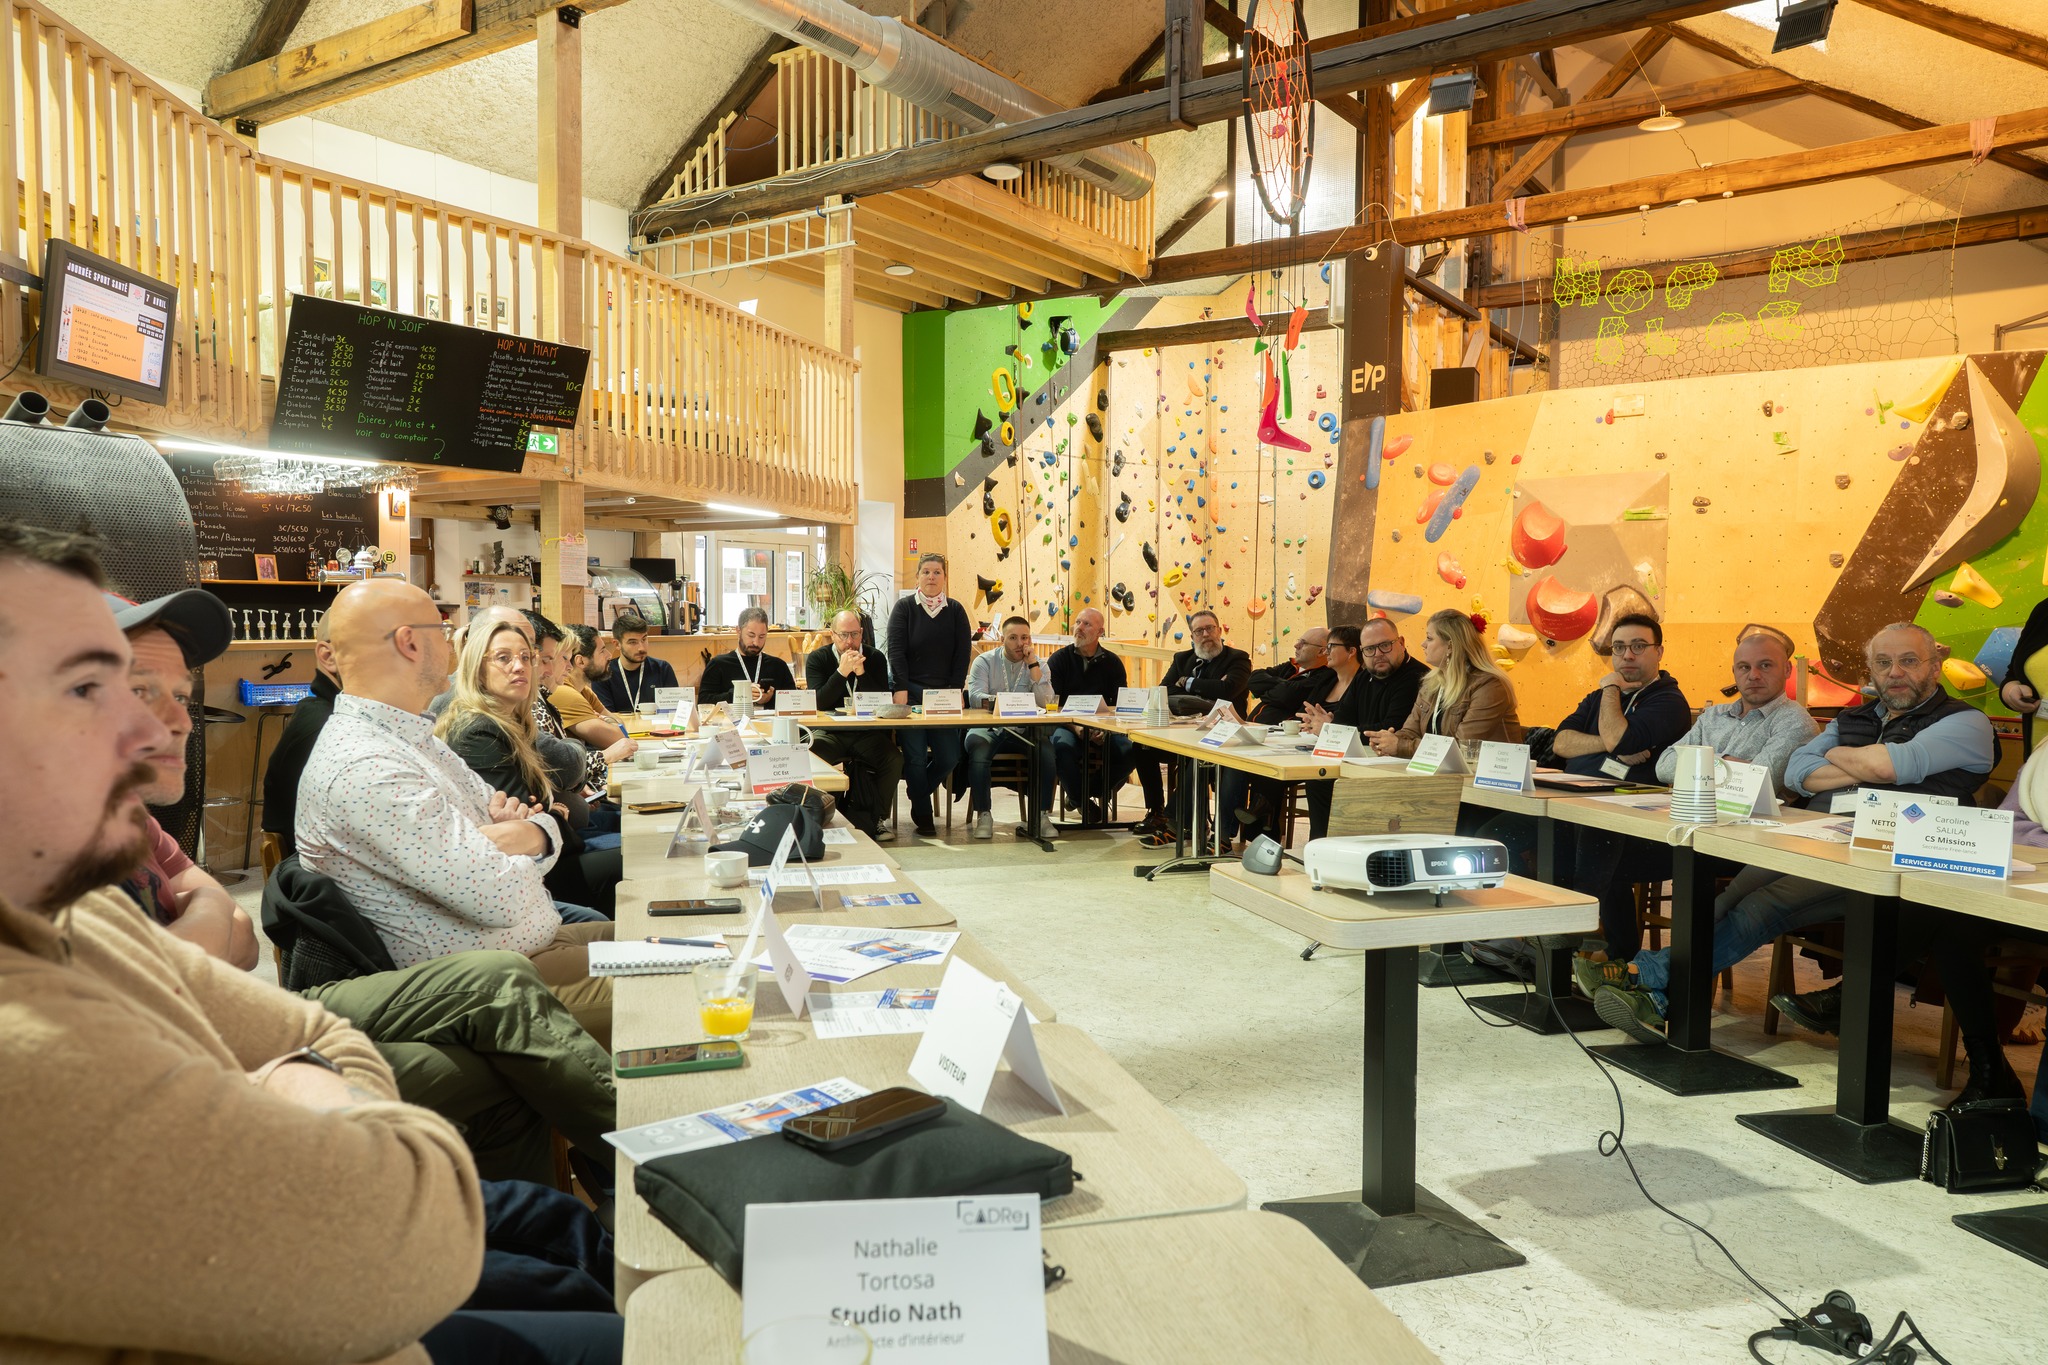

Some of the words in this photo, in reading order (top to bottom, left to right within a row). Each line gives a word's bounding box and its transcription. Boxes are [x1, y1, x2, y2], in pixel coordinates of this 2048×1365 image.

[67, 262, 92, 279] JOURNÉE
[93, 271, 111, 286] SPORT
[112, 279, 128, 293] SANTÉ
[153, 296, 167, 309] AVRIL
[400, 320, 426, 333] SOIF
[301, 330, 312, 340] Jus
[313, 333, 321, 341] de
[298, 340, 317, 348] Cola
[375, 340, 394, 351] Café
[373, 349, 389, 359] Café
[533, 342, 558, 358] MIAM
[310, 368, 326, 376] plate
[291, 375, 304, 383] Eau
[289, 385, 309, 394] Sirop
[288, 393, 321, 401] Limonade
[287, 400, 312, 409] Diabolo
[395, 419, 411, 429] vins
[415, 421, 425, 429] et
[356, 429, 373, 437] voir
[394, 433, 428, 443] comptoir
[190, 465, 206, 475] Les
[1871, 819, 1897, 828] NETTO
[1935, 815, 1970, 826] Caroline
[1936, 826, 1967, 837] SALILAJ
[1924, 835, 1936, 843] CS
[1937, 837, 1977, 847] Missions
[1922, 843, 1948, 852] Secrétaire
[1900, 858, 1932, 868] SERVICES
[1933, 861, 1949, 869] AUX
[1949, 863, 1996, 875] ENTREPRISES
[938, 1053, 967, 1086] VISITEUR
[854, 1237, 939, 1260] Nathalie
[857, 1271, 935, 1292] Tortosa
[829, 1304, 901, 1326] Studio
[908, 1302, 962, 1322] Nath
[898, 1331, 966, 1348] d'intérieur
